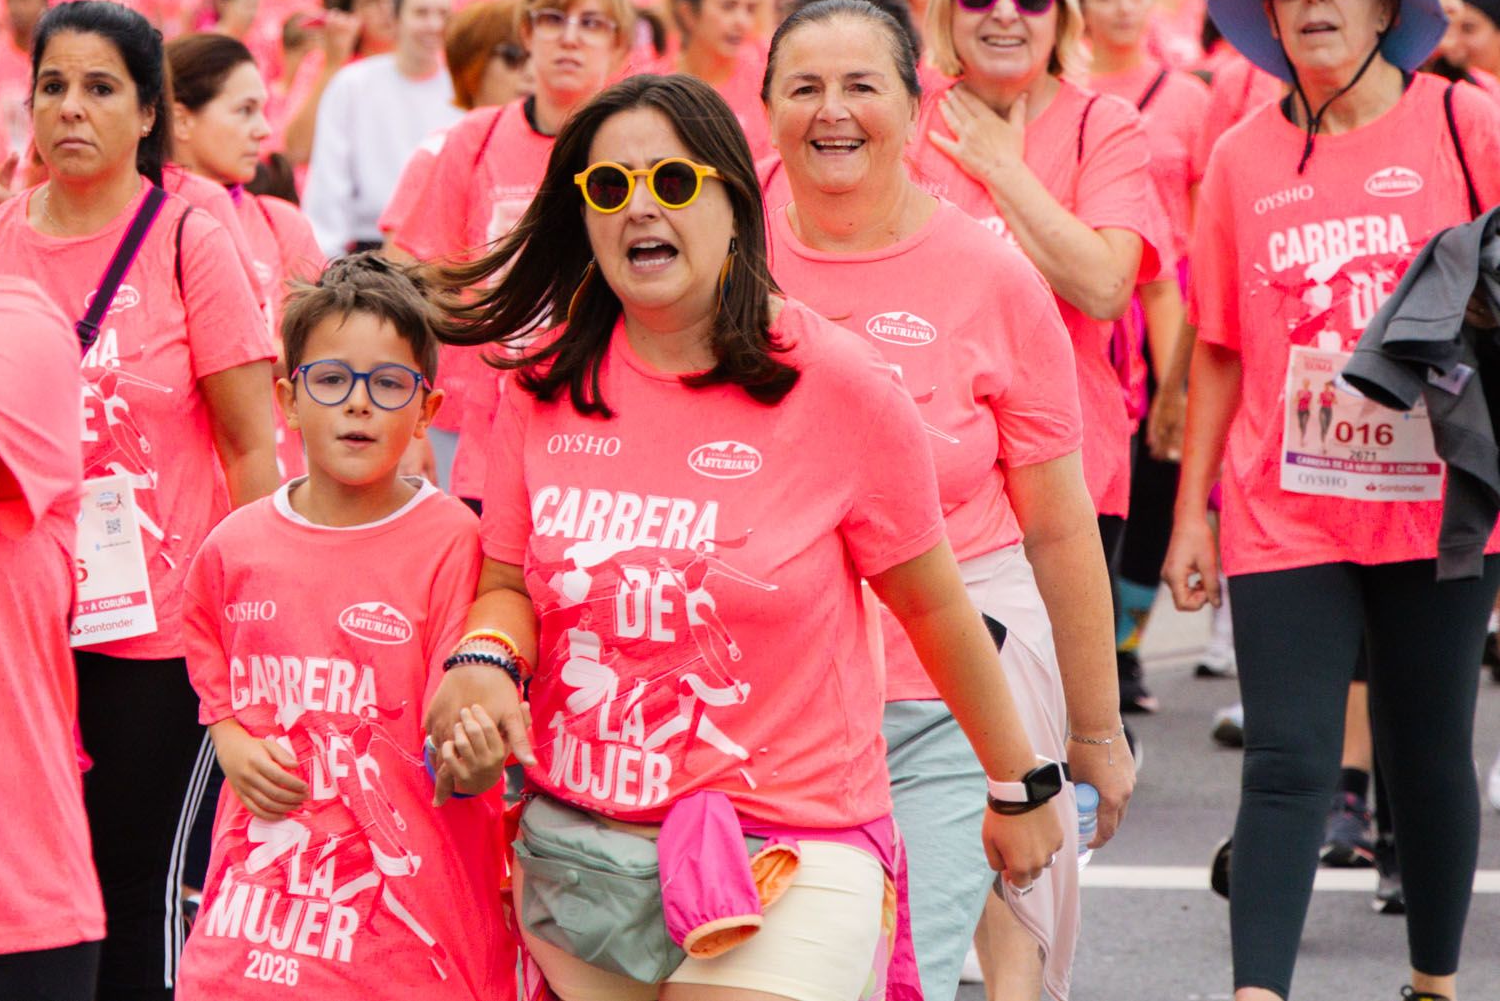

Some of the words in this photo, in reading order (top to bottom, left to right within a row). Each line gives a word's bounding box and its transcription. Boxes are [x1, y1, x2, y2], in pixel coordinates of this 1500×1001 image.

[1254, 184, 1314, 215] OYSHO
[1267, 213, 1412, 272] CARRERA
[871, 319, 931, 341] ASTURIANA
[81, 385, 99, 442] E
[547, 433, 621, 456] OYSHO
[1335, 421, 1394, 446] 016
[693, 451, 756, 471] ASTURIANA
[1332, 459, 1342, 469] DE
[1344, 461, 1354, 470] LA
[1350, 450, 1377, 462] 2671
[1298, 473, 1347, 488] OYSHO
[1378, 483, 1425, 493] Santander
[532, 485, 719, 552] CARRERA
[98, 596, 133, 611] CORUÑA
[615, 565, 684, 642] DE
[83, 618, 135, 636] Santander
[343, 611, 407, 640] ASTURIANA
[229, 654, 379, 718] CARRERA
[598, 678, 645, 747] LA
[309, 731, 351, 801] DE
[288, 834, 337, 898] LA
[204, 882, 359, 963] MUJER
[244, 949, 300, 987] 2026
